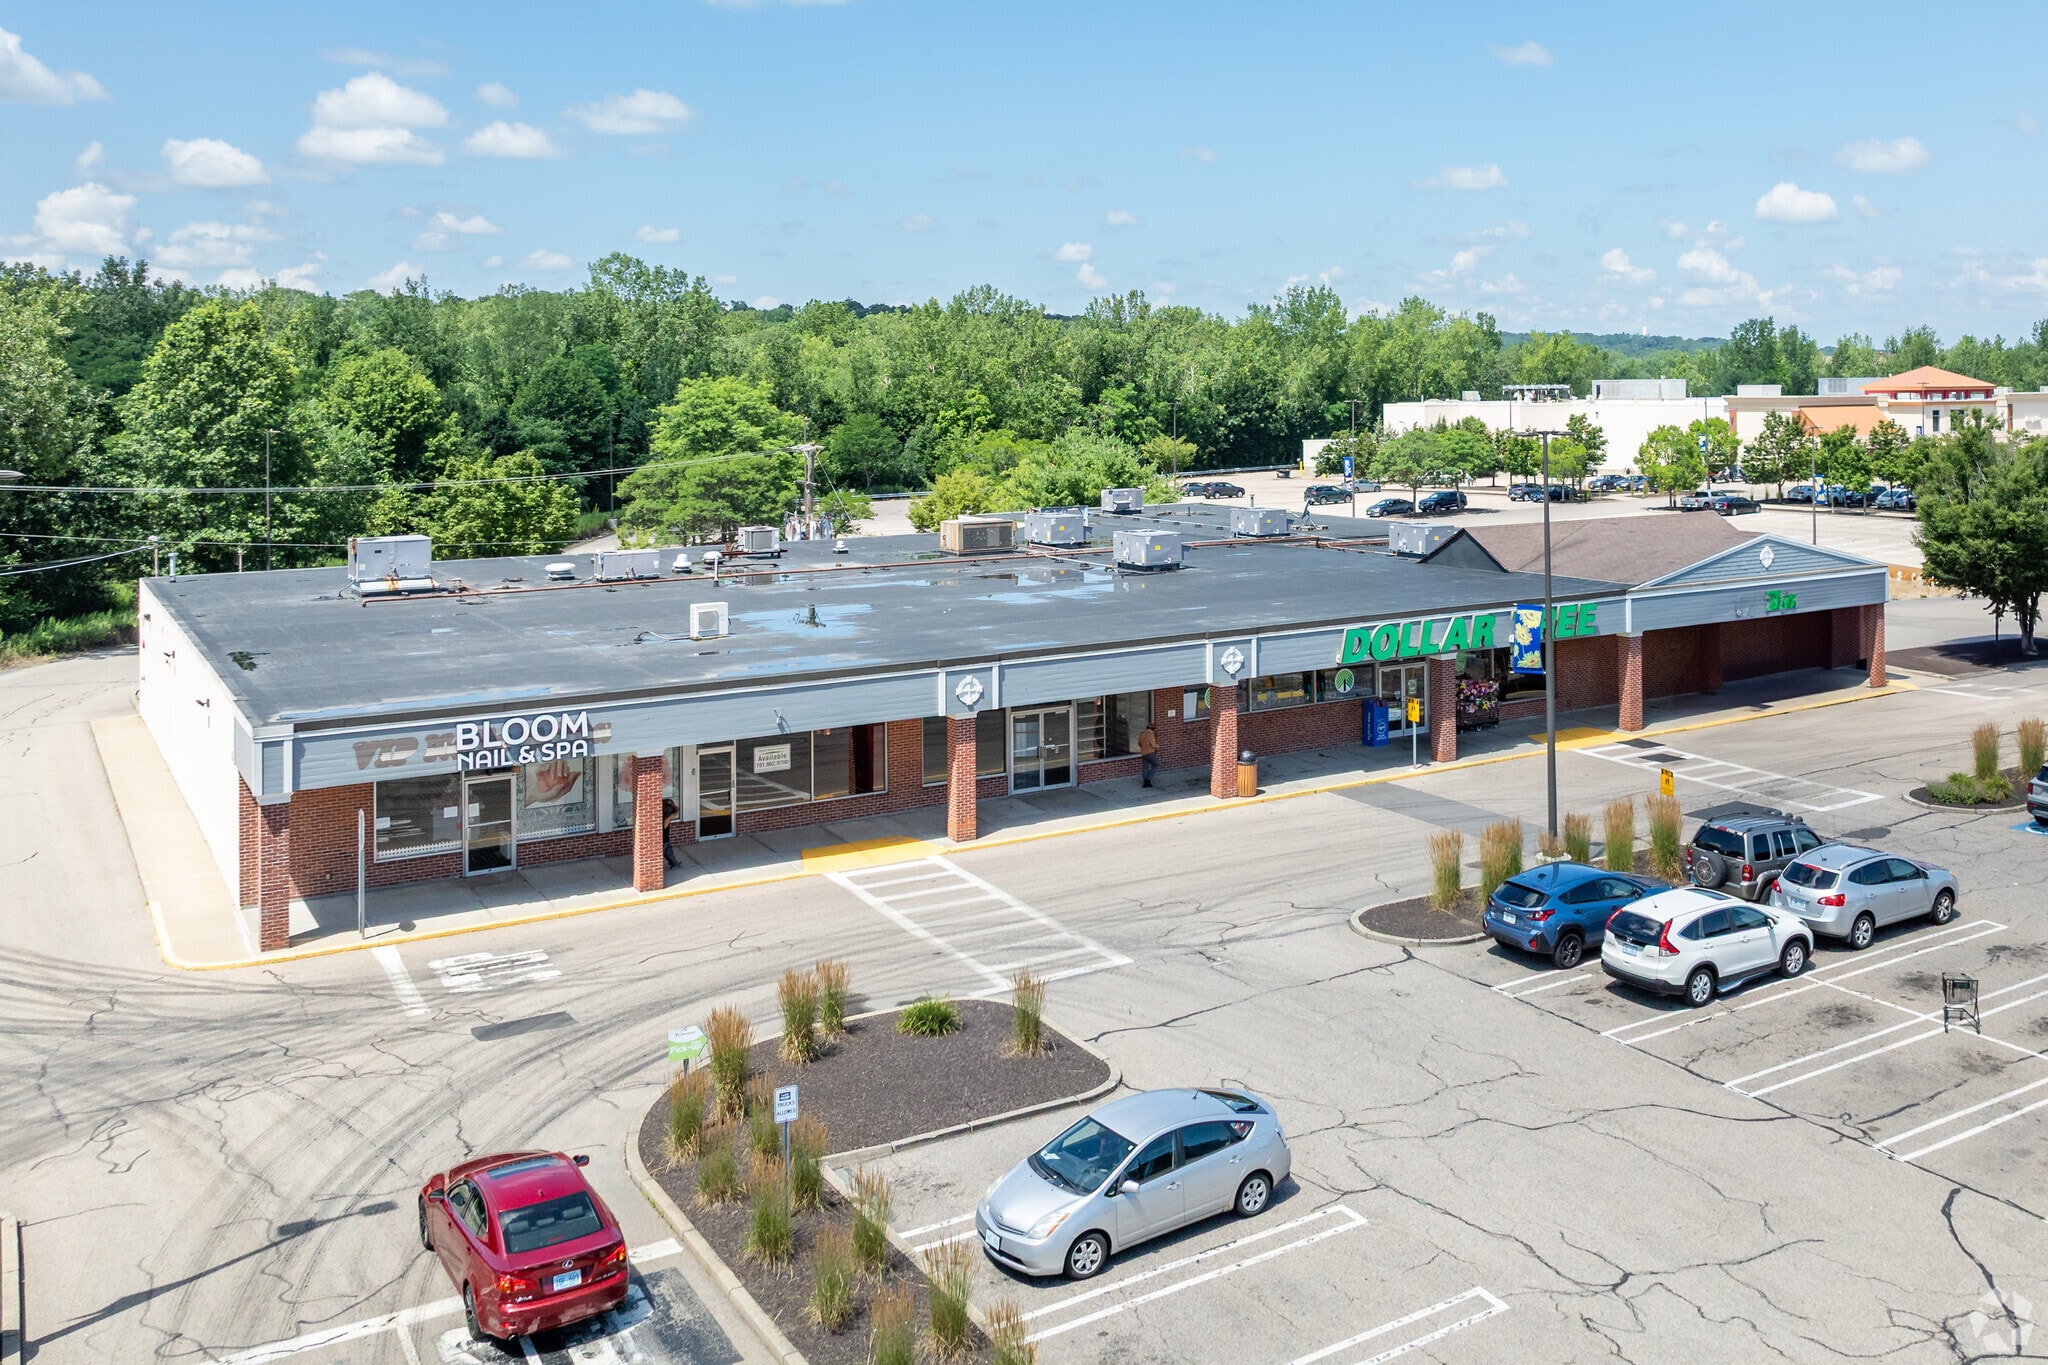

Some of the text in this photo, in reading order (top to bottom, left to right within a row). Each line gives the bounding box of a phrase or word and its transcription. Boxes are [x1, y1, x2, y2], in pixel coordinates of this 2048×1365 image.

[1340, 602, 1598, 664] DOLLAR EE
[456, 711, 589, 751] BLOOM
[457, 748, 513, 771] NAIL
[518, 745, 536, 764] &
[541, 739, 588, 761] SPA
[757, 753, 787, 762] Available
[777, 1100, 796, 1108] TRUCKS
[777, 1108, 796, 1116] ALLOWED
